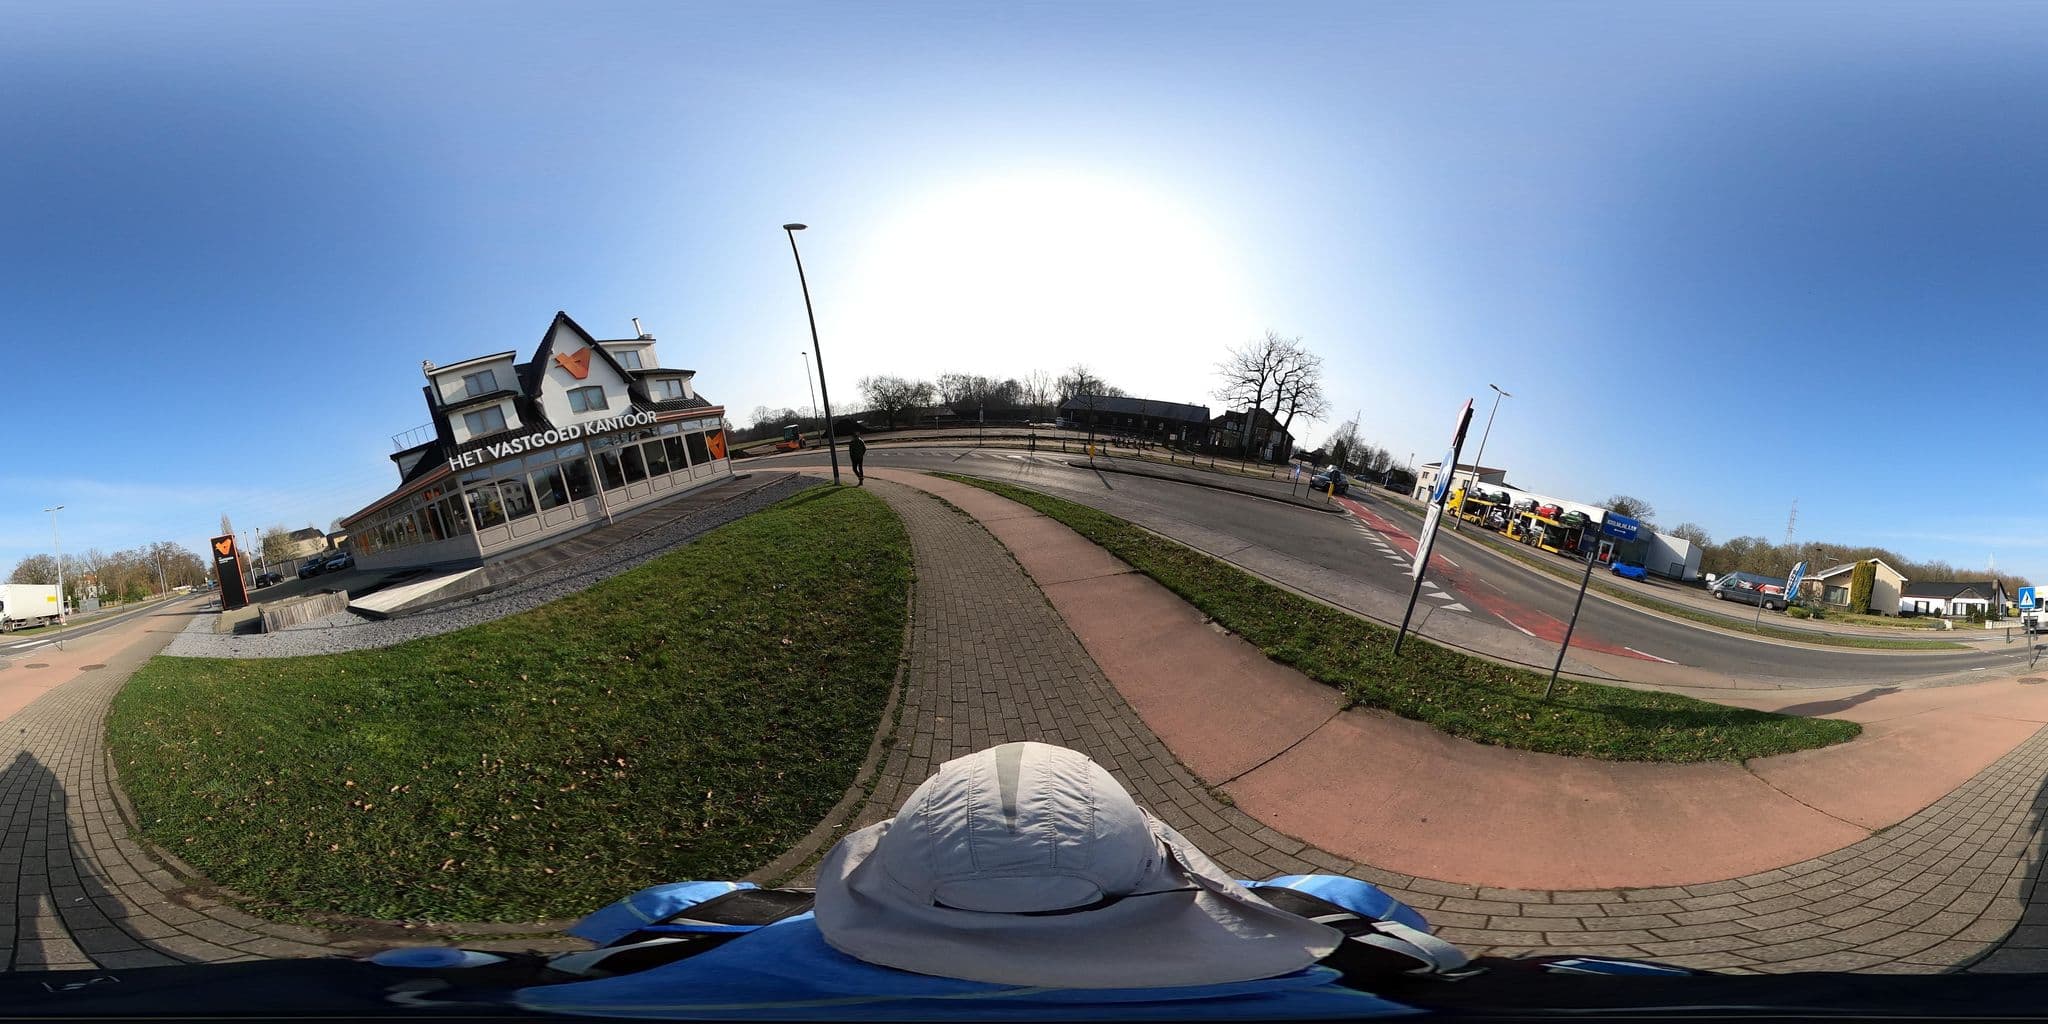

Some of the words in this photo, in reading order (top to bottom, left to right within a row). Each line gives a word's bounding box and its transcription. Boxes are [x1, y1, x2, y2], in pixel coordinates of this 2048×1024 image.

[449, 449, 483, 472] HET
[487, 425, 580, 459] VASTGOED
[585, 410, 657, 436] KANTOOR
